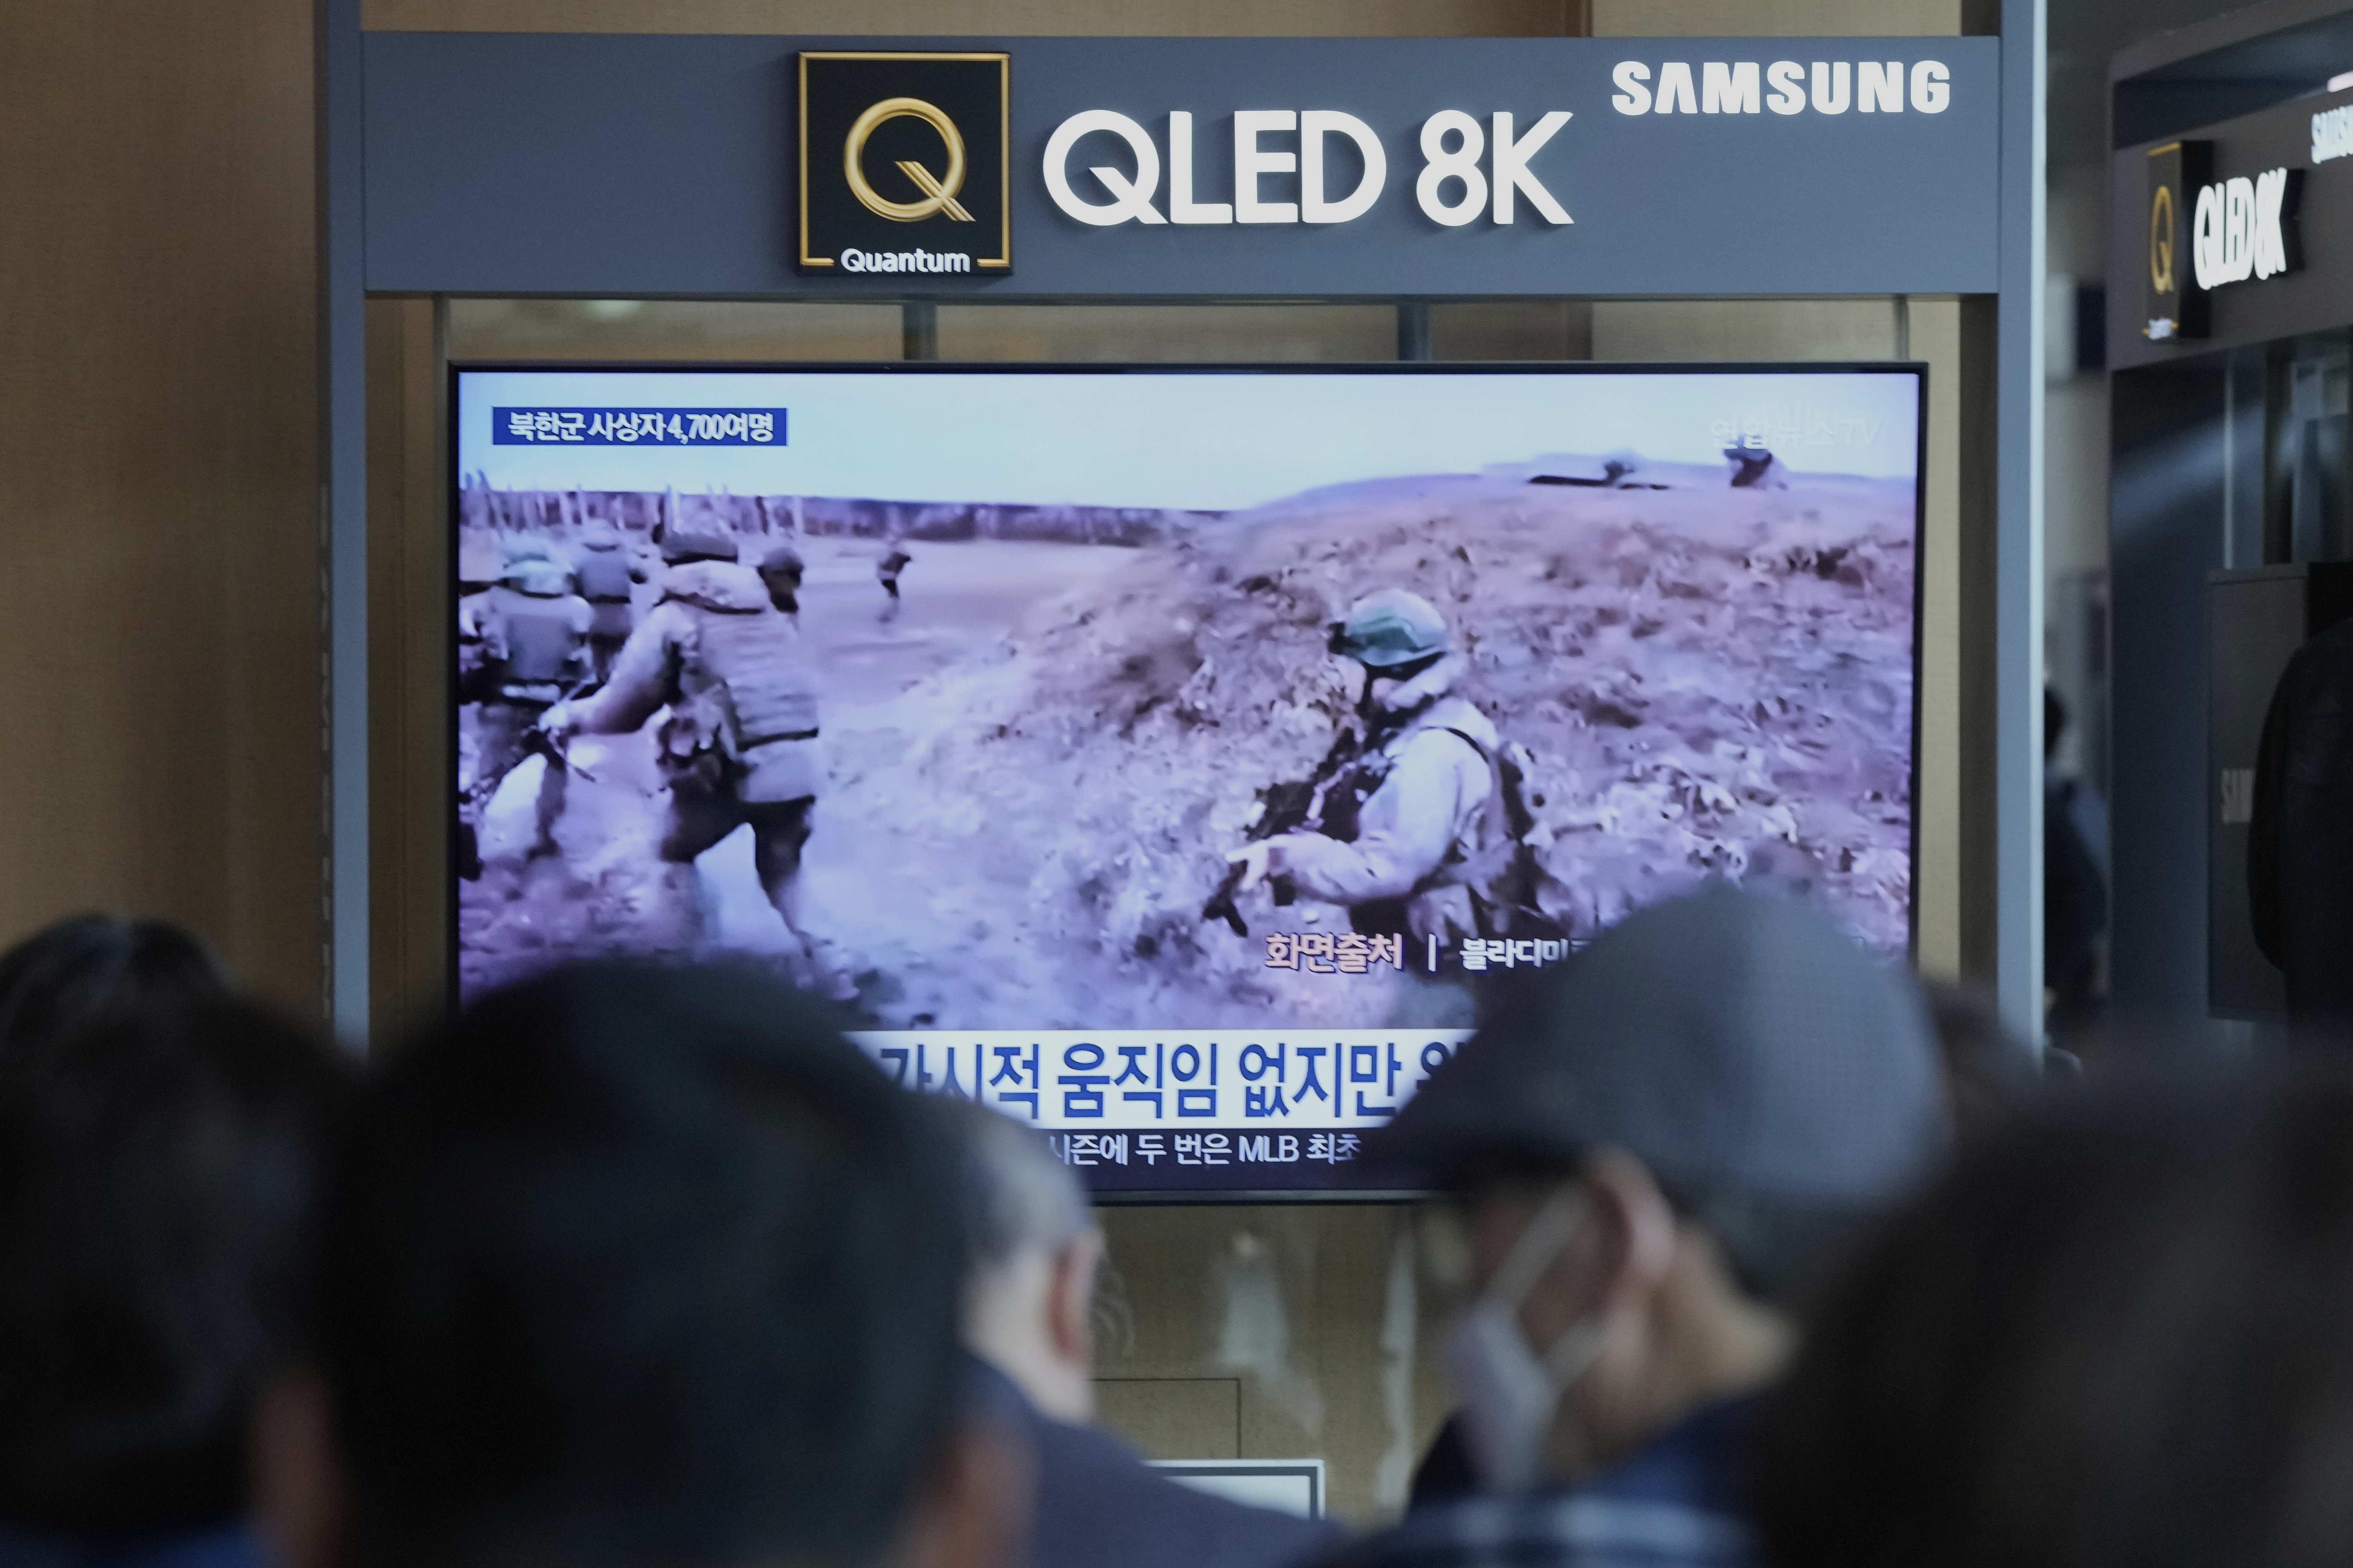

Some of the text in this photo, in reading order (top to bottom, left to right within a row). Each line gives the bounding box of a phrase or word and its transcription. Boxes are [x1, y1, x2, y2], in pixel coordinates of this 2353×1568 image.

[1612, 60, 1950, 116] SAMSUNG
[1043, 109, 1574, 227] QLED 8K
[840, 248, 971, 273] Quantum
[507, 412, 773, 444] 북한군 사상자 4,700여명
[1265, 932, 1402, 973] 화면출처
[1057, 1042, 1217, 1119] 움직임
[1239, 1042, 1402, 1118] 없지만
[1135, 1134, 1167, 1165] 두
[1175, 1133, 1233, 1165] 번은
[1238, 1135, 1300, 1162] MLB
